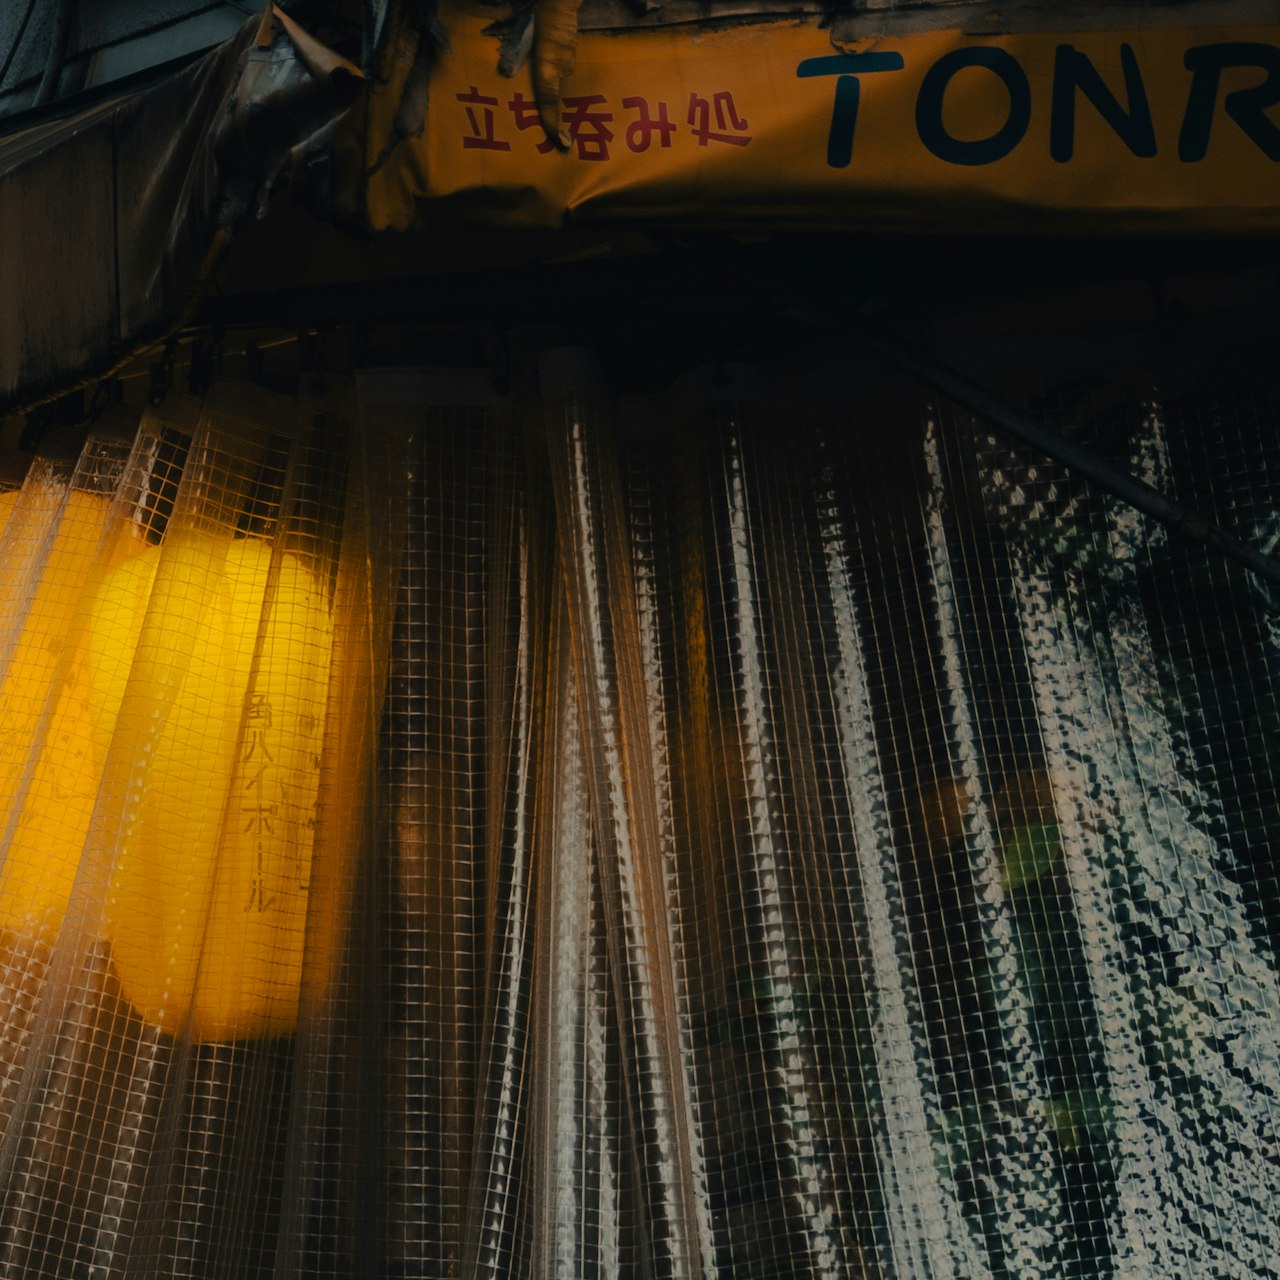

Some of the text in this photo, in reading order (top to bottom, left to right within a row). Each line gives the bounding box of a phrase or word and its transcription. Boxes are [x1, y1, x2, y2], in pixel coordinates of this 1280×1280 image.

[455, 85, 753, 162] 立ち呑み処
[796, 42, 1280, 168] TONR
